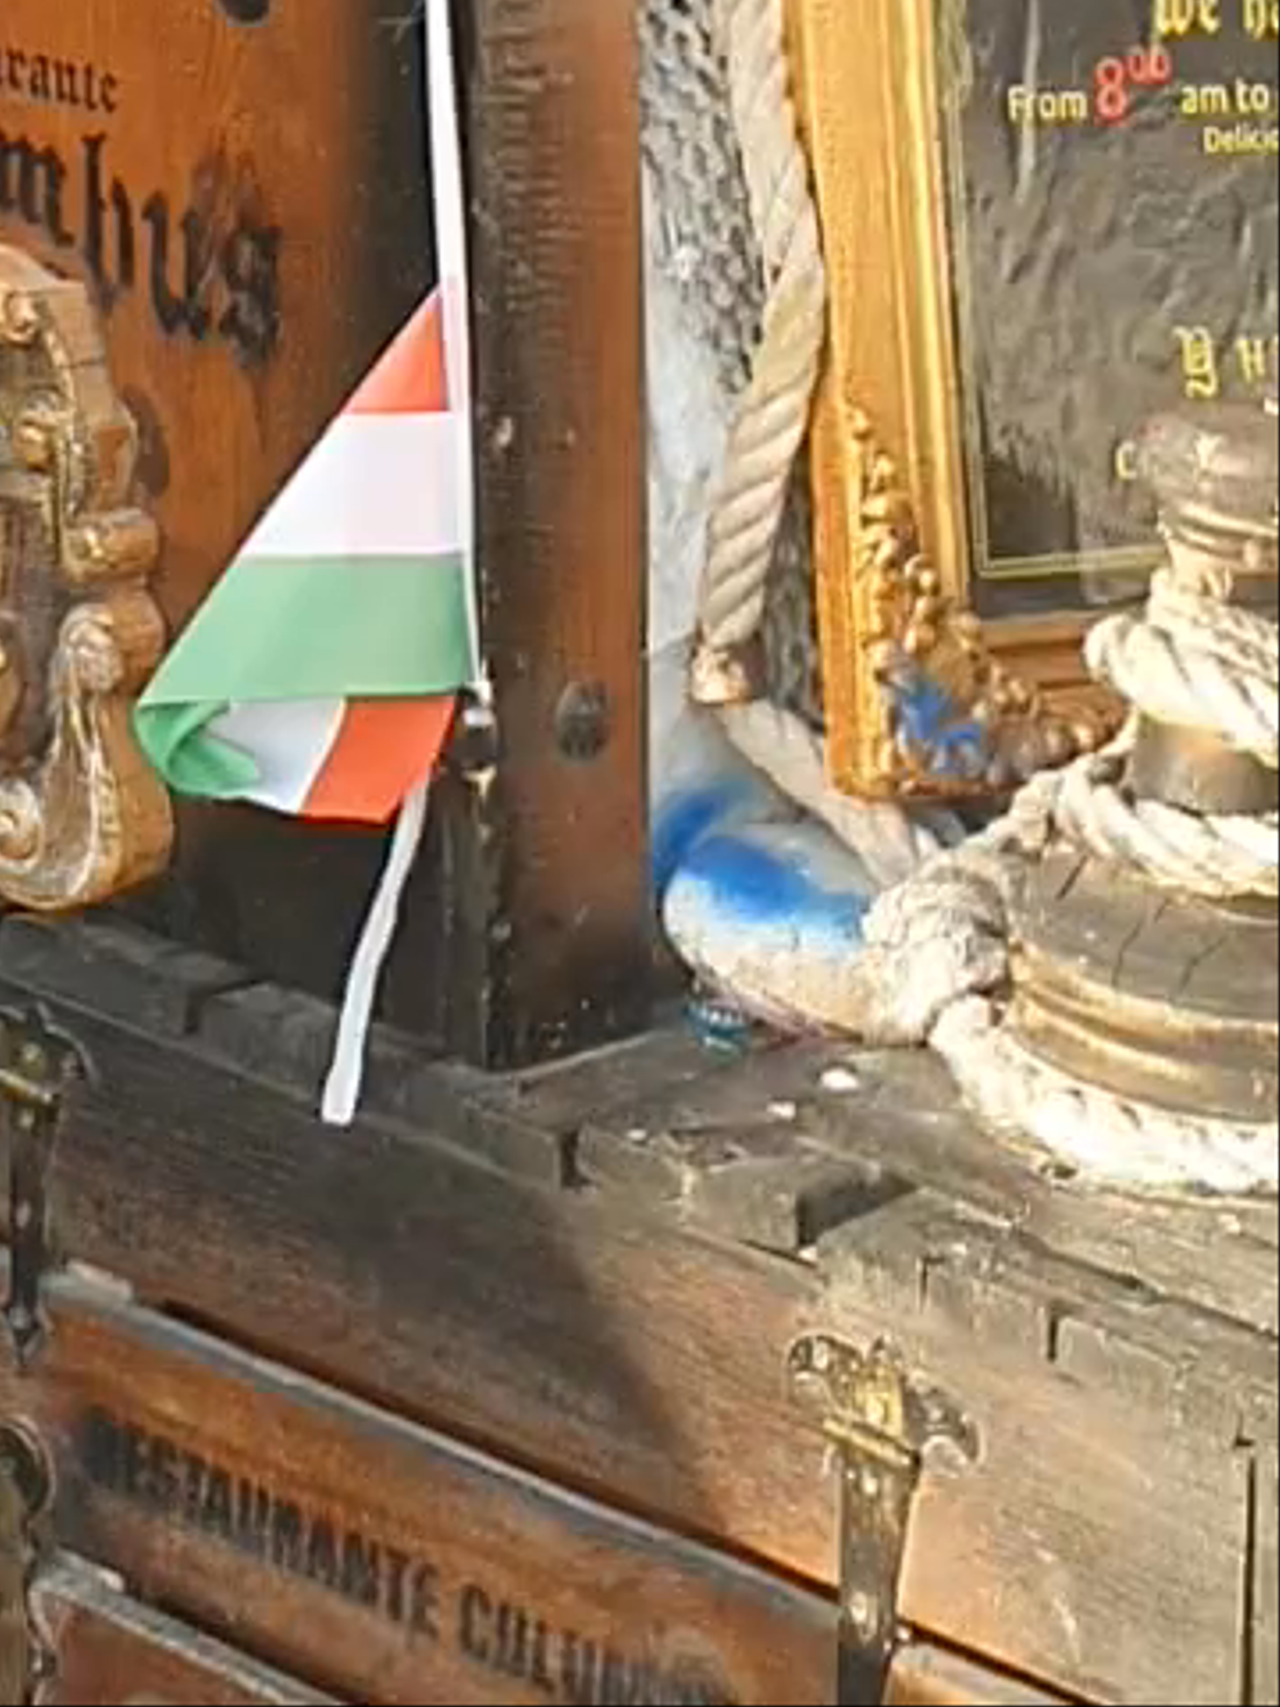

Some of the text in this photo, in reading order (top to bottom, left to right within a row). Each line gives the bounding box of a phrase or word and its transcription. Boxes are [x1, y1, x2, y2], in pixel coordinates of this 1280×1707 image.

[1007, 82, 1088, 122] From
[1181, 83, 1228, 115] am
[1235, 77, 1269, 113] to
